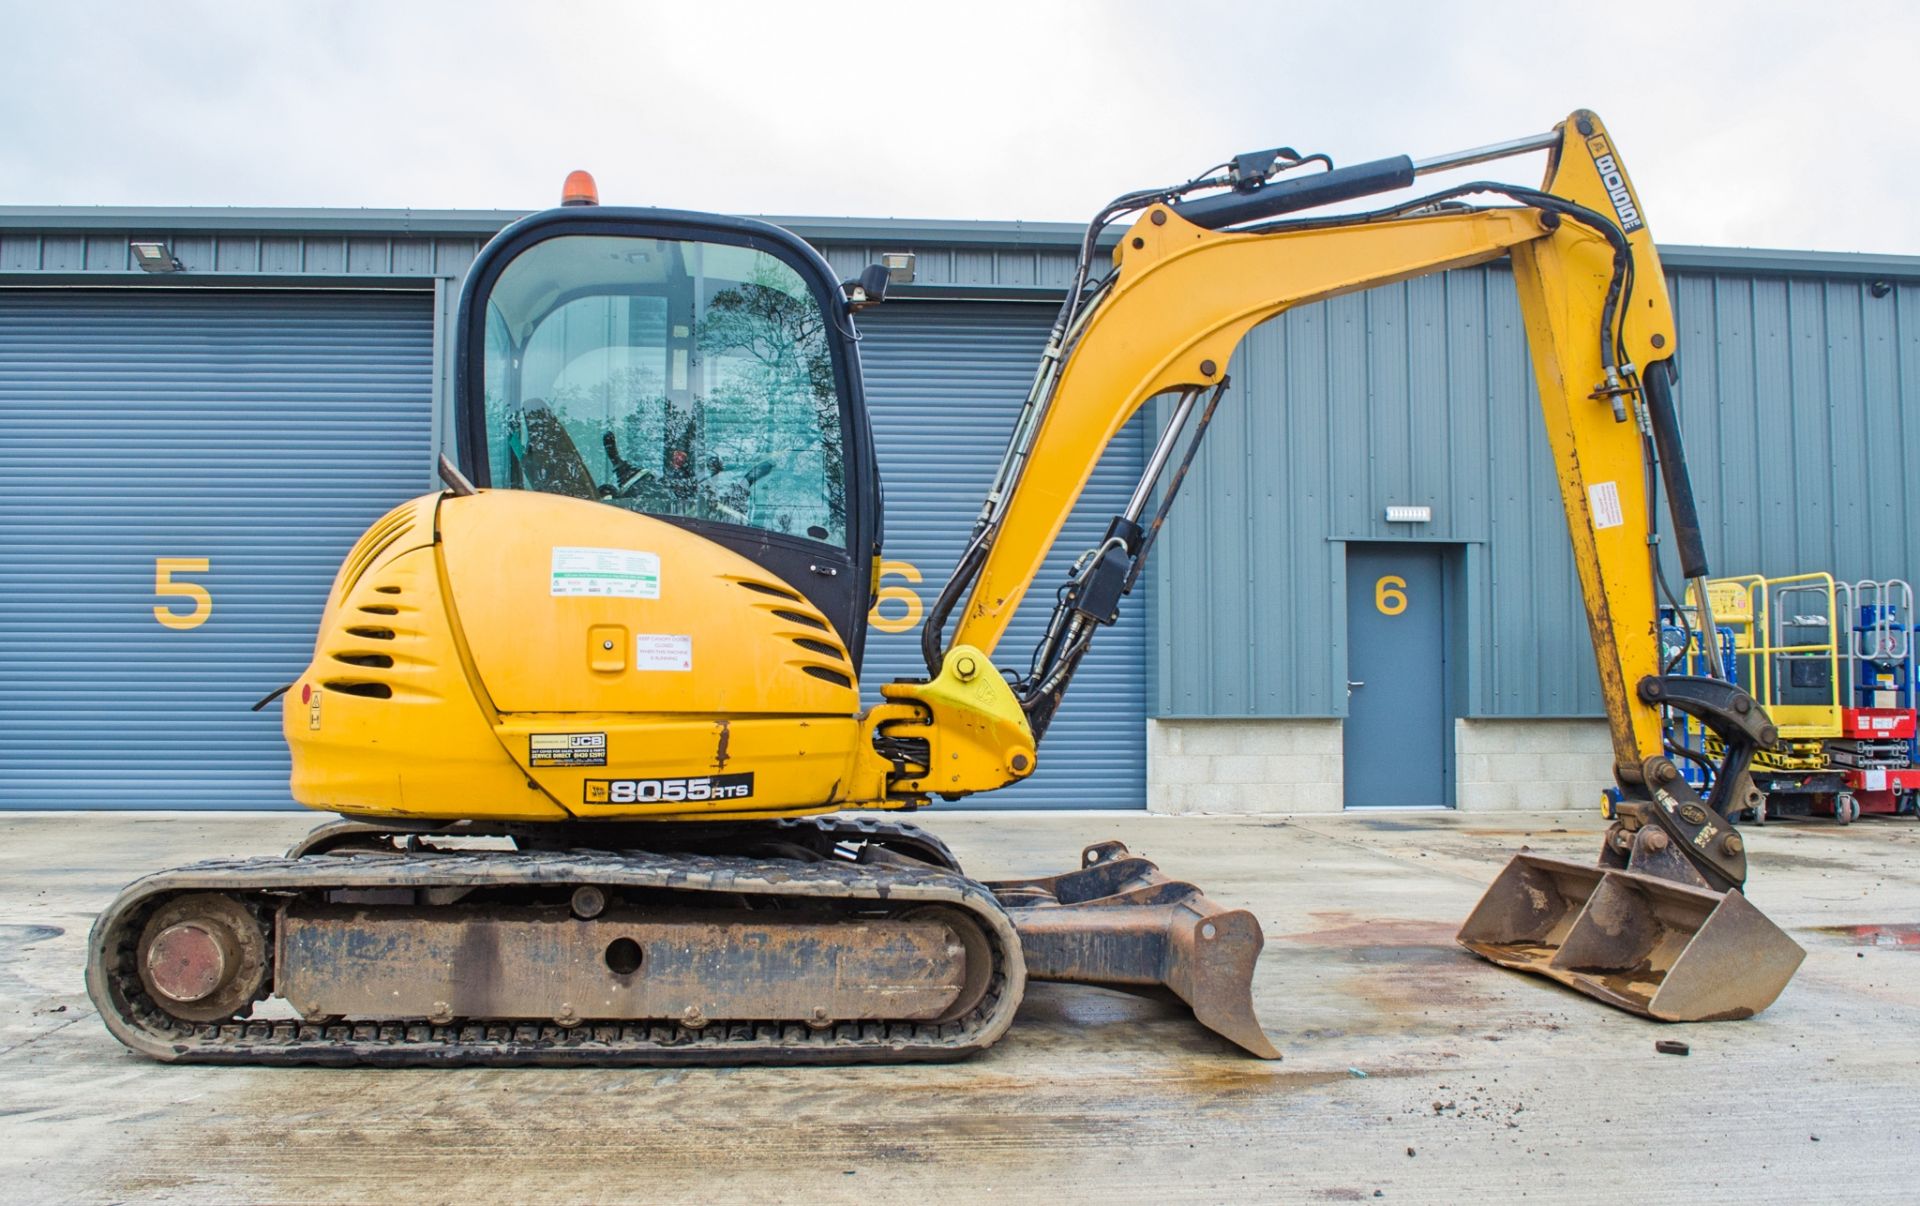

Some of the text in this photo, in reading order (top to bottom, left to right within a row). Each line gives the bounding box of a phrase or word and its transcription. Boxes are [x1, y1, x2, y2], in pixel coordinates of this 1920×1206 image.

[153, 557, 213, 630] 5
[868, 561, 924, 633] 6
[1376, 575, 1408, 616] 6
[571, 736, 603, 746] JCB
